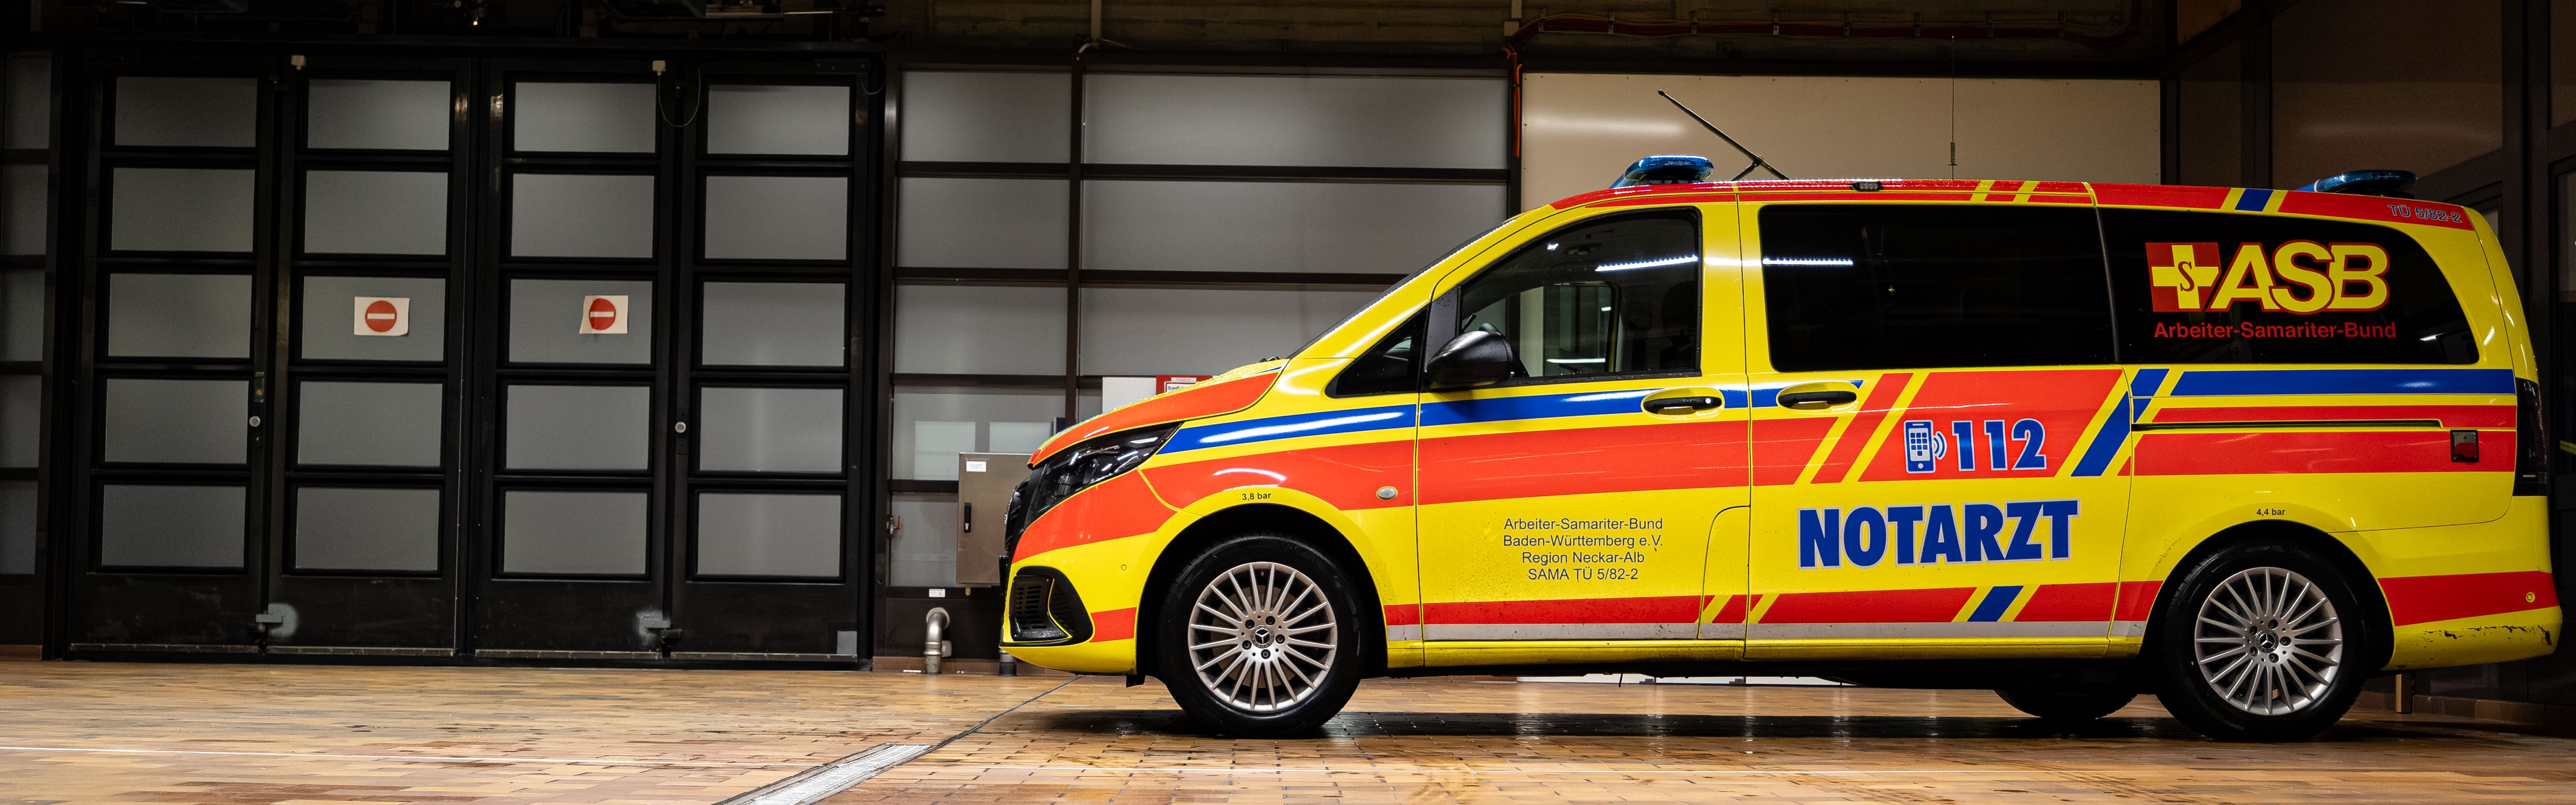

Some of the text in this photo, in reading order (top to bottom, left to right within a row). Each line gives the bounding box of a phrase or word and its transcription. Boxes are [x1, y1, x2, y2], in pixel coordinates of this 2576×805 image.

[2387, 204, 2463, 223] TÜ 5/82-2
[2206, 239, 2391, 315] ASB
[2153, 321, 2397, 338] Arbeiter-Samariter-Bund
[1951, 418, 2047, 471] 112
[1242, 493, 1255, 501] 3,8
[2256, 508, 2269, 517] 4,4
[1504, 517, 1663, 530] Arbeiter-Samariter-Bund
[1504, 534, 1663, 549] Baden-Württemberg e.V.
[1797, 498, 2080, 570] NOTARZT
[1522, 551, 1645, 566] Region Neckar-Alb
[1528, 566, 1639, 580] SAMA TÜ 5/82-2
